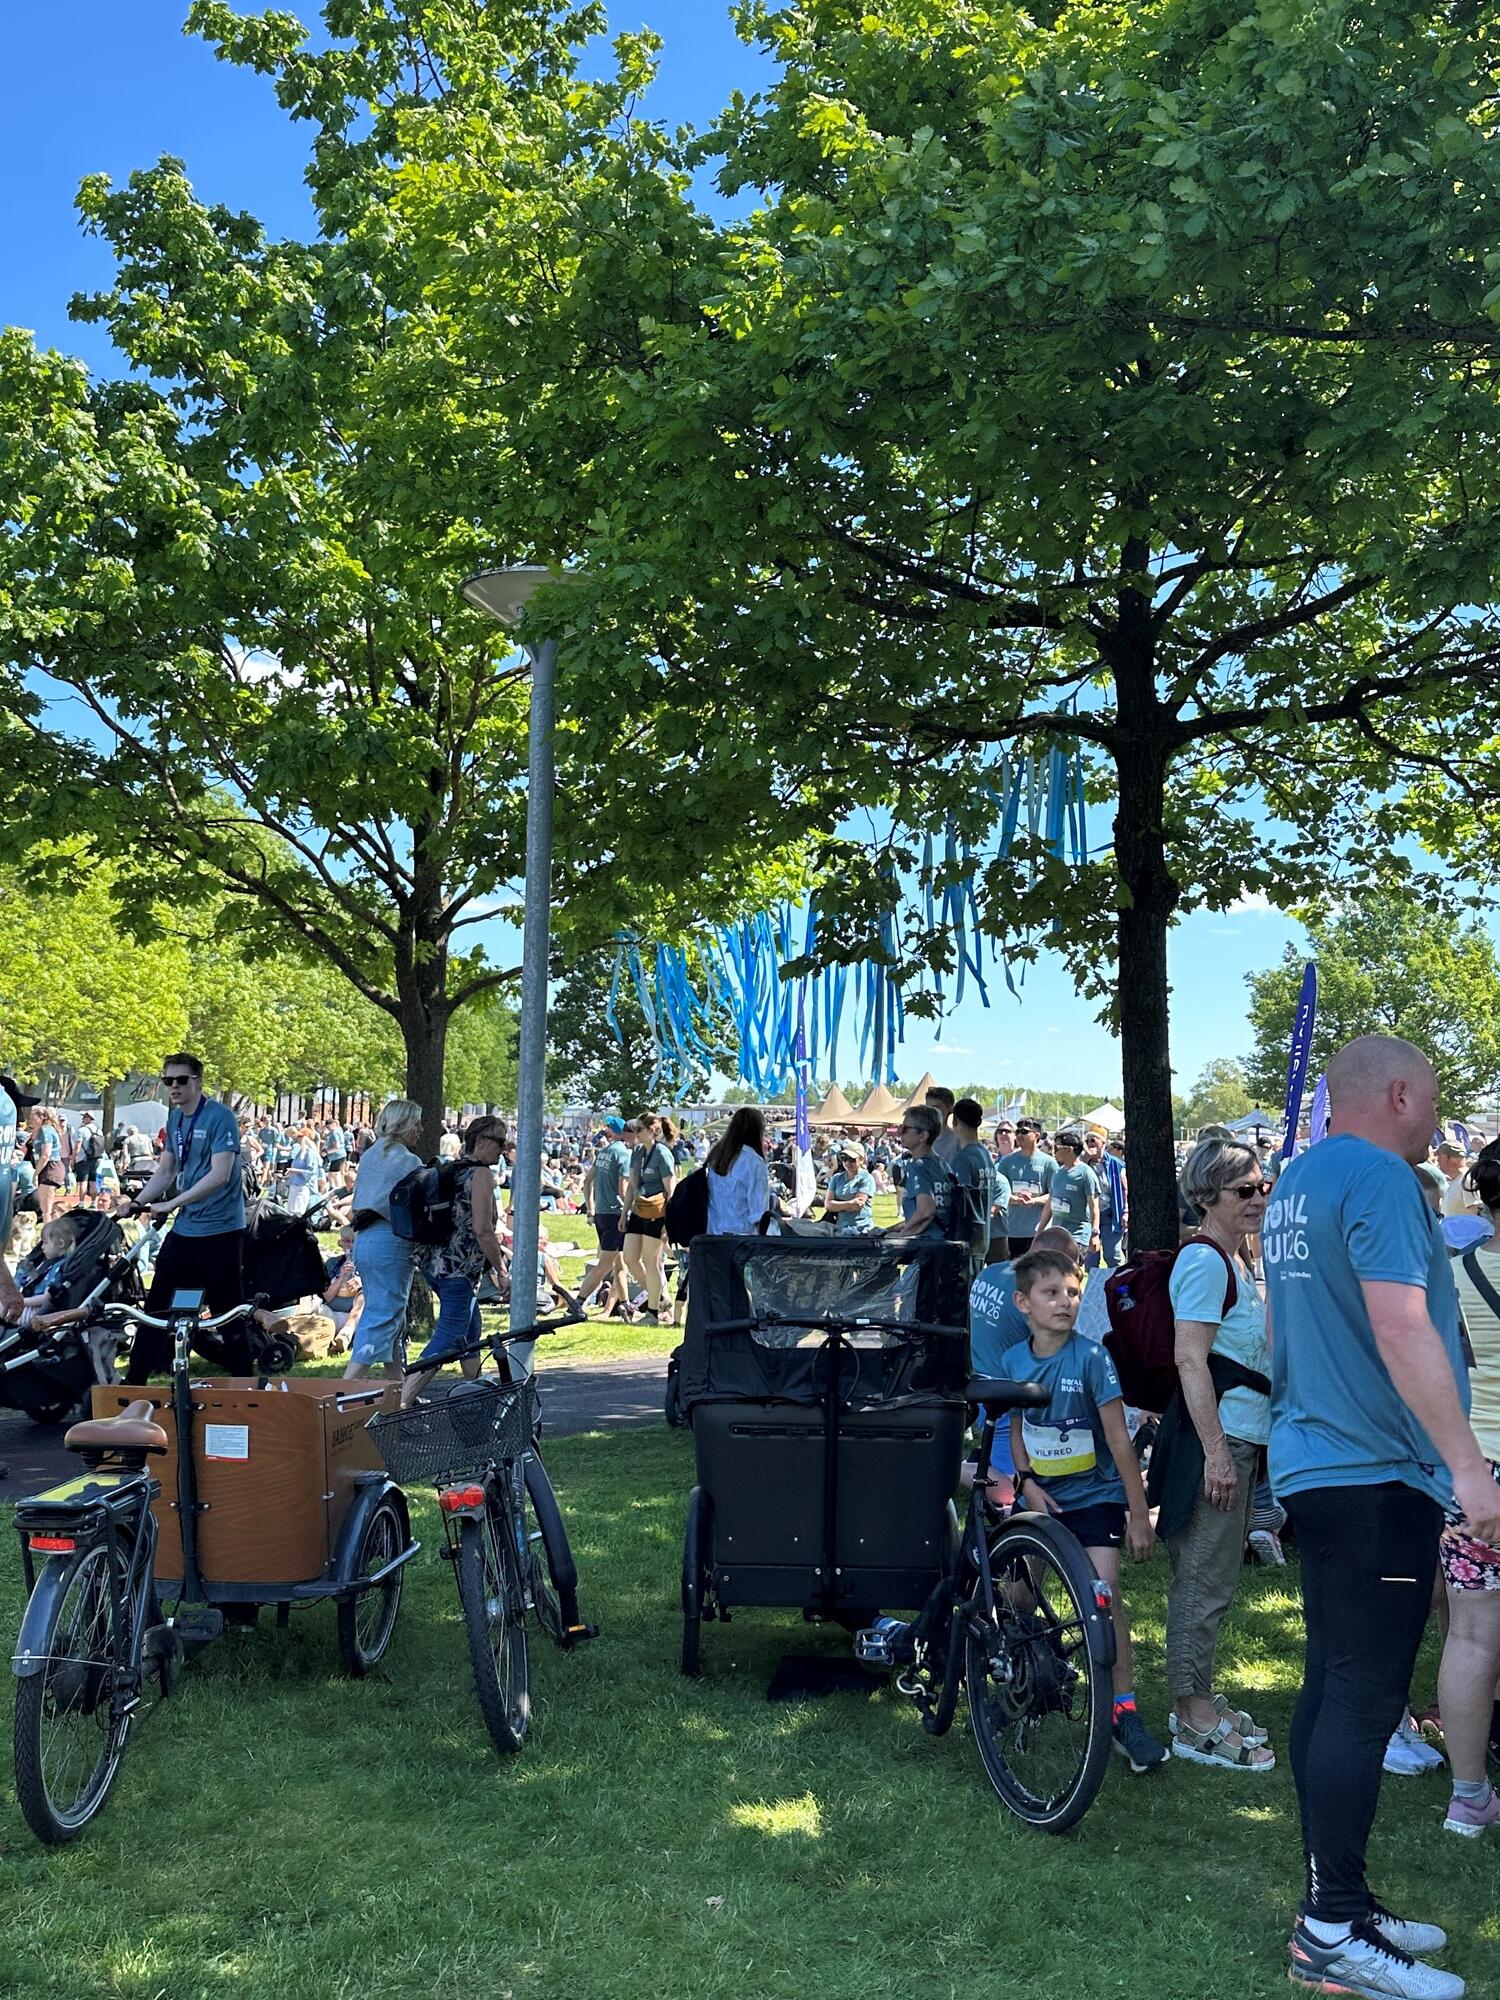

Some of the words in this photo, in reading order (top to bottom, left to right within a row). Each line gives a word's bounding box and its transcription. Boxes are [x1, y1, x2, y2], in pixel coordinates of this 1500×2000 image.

[971, 1279, 1005, 1305] ROYAL
[1061, 1378, 1083, 1387] ROYAL
[1035, 1447, 1072, 1456] VILFRED
